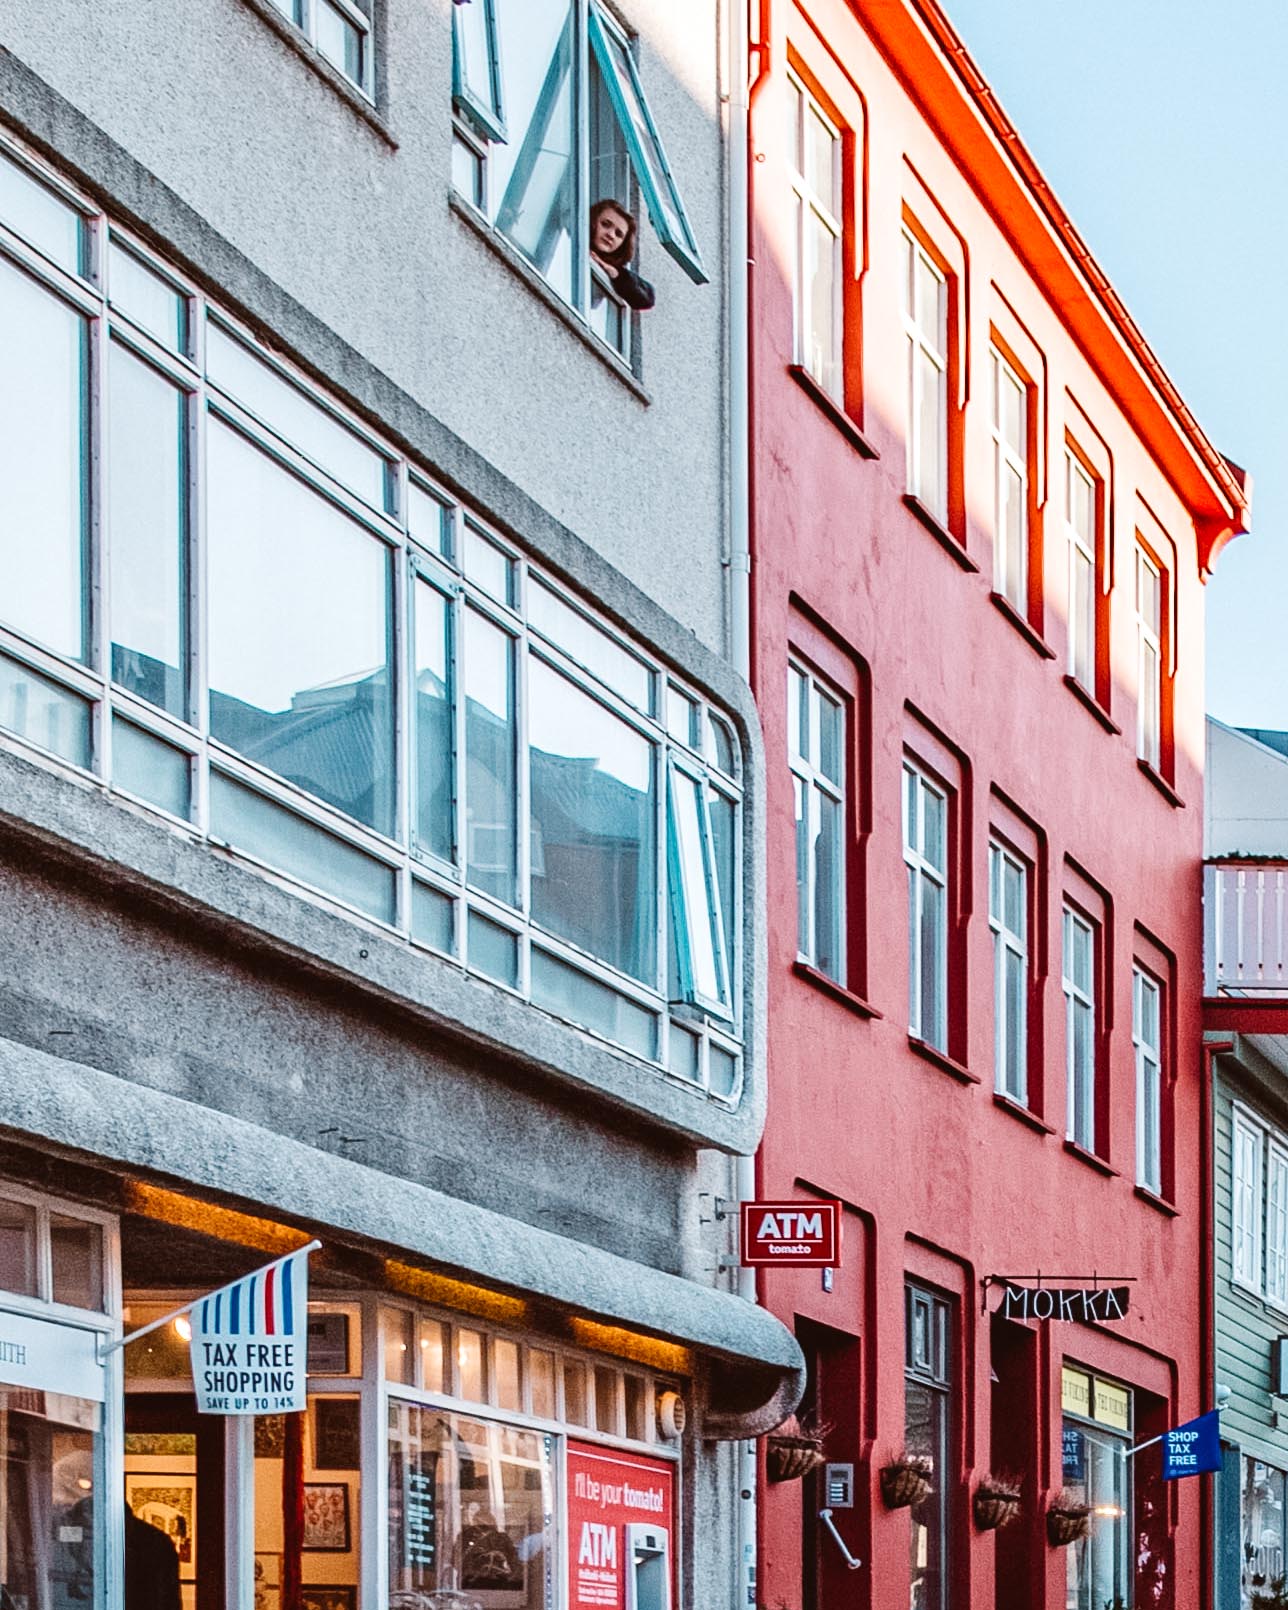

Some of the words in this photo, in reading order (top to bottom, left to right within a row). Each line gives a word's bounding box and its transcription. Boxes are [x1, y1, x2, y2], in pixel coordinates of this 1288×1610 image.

[756, 1212, 824, 1239] ATM
[768, 1243, 812, 1255] tomato
[1005, 1286, 1125, 1325] MOKKA
[202, 1342, 237, 1367] TAX
[245, 1343, 294, 1368] FREE
[204, 1370, 294, 1393] SHOPPING
[207, 1396, 229, 1409] SAVE
[234, 1397, 250, 1409] UP
[255, 1397, 268, 1409] TO
[274, 1396, 294, 1408] 14%
[1168, 1431, 1199, 1443] SHOP
[1168, 1444, 1191, 1454] TAX
[1169, 1454, 1198, 1466] FREE
[586, 1477, 601, 1501] be
[600, 1483, 623, 1509] your
[623, 1482, 664, 1513] tomato!
[578, 1521, 617, 1570] ATM
